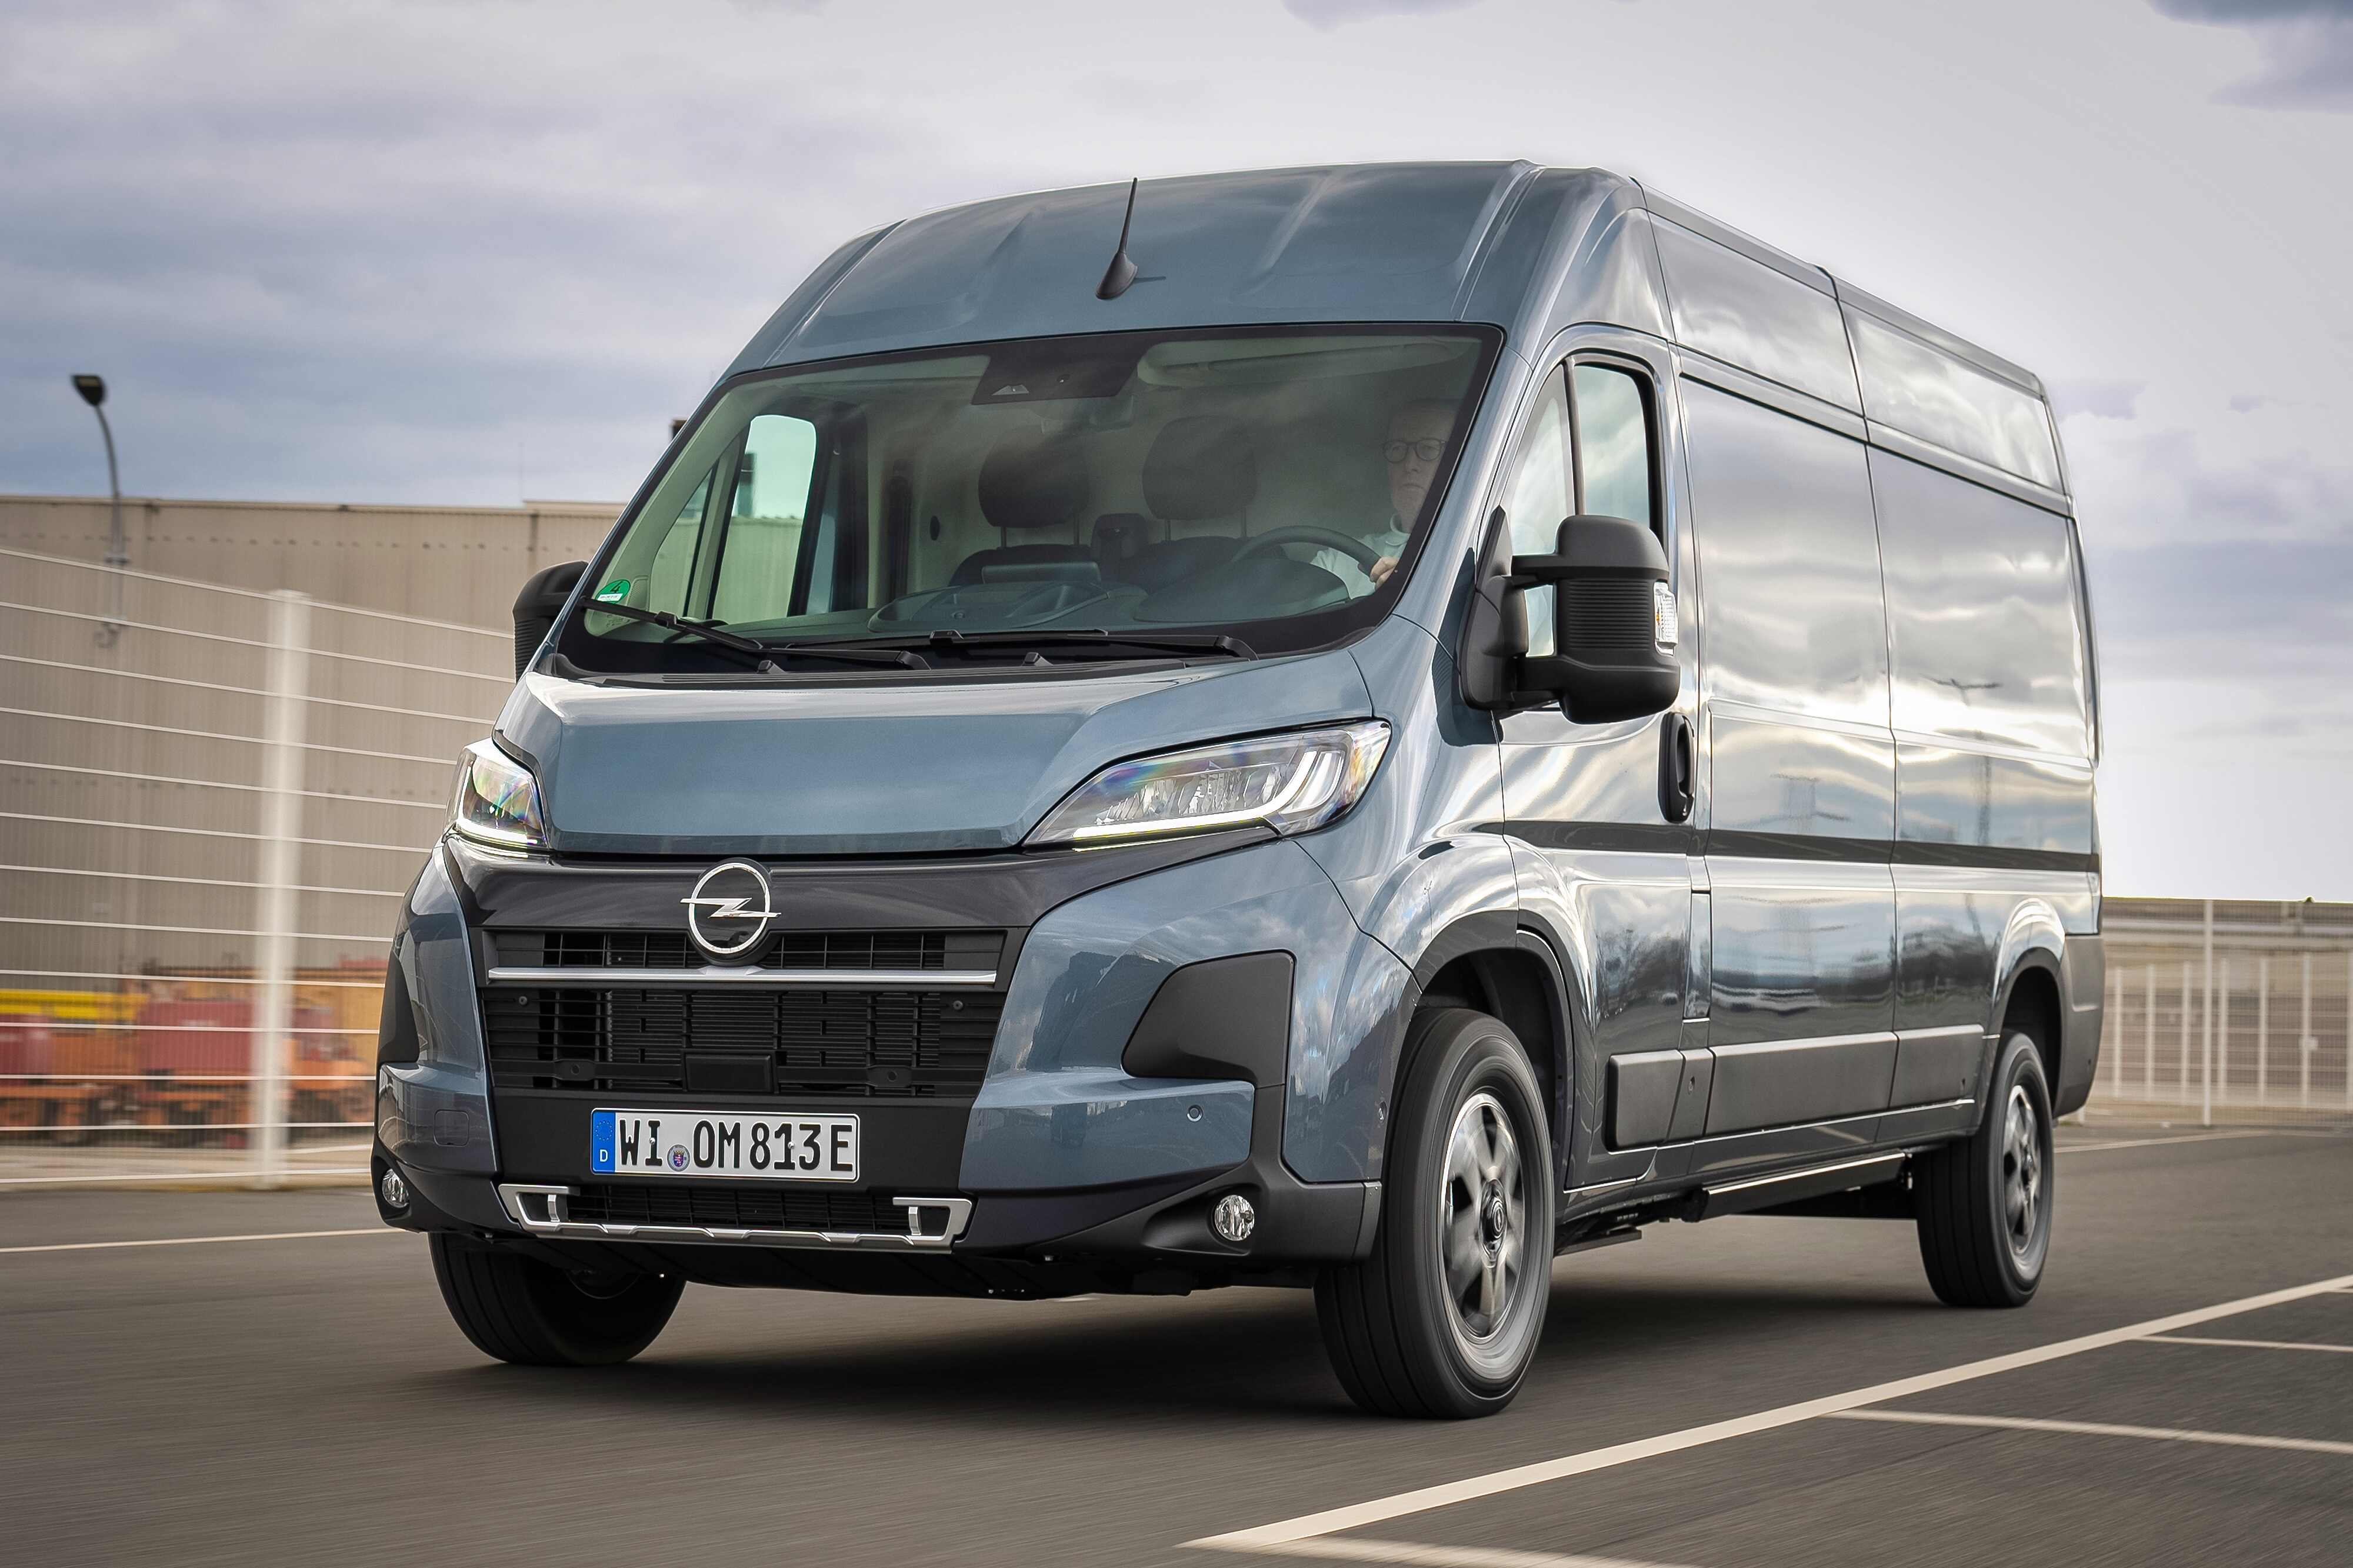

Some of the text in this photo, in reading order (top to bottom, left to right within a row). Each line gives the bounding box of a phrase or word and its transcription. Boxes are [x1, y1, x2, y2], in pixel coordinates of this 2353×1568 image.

[610, 581, 622, 593] 4
[619, 1119, 662, 1166] WI
[599, 1149, 608, 1162] D
